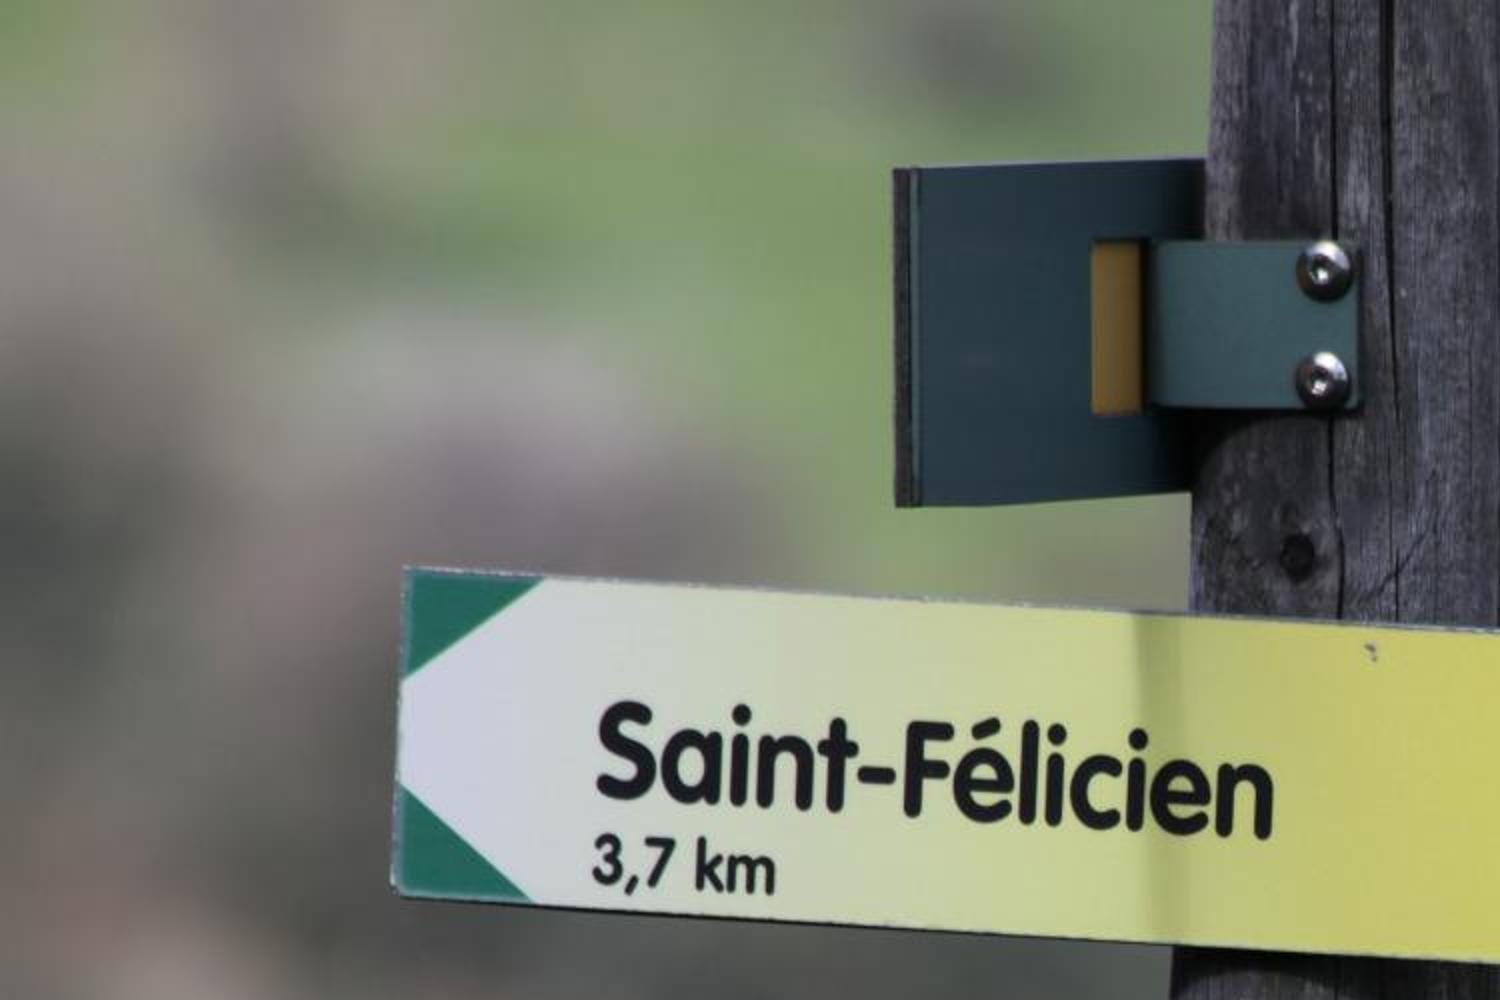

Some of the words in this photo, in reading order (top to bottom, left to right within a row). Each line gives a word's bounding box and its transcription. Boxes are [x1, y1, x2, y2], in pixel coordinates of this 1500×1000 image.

[596, 699, 1275, 842] Saint-Félicien
[592, 832, 677, 897] 3,7
[695, 835, 776, 897] km
